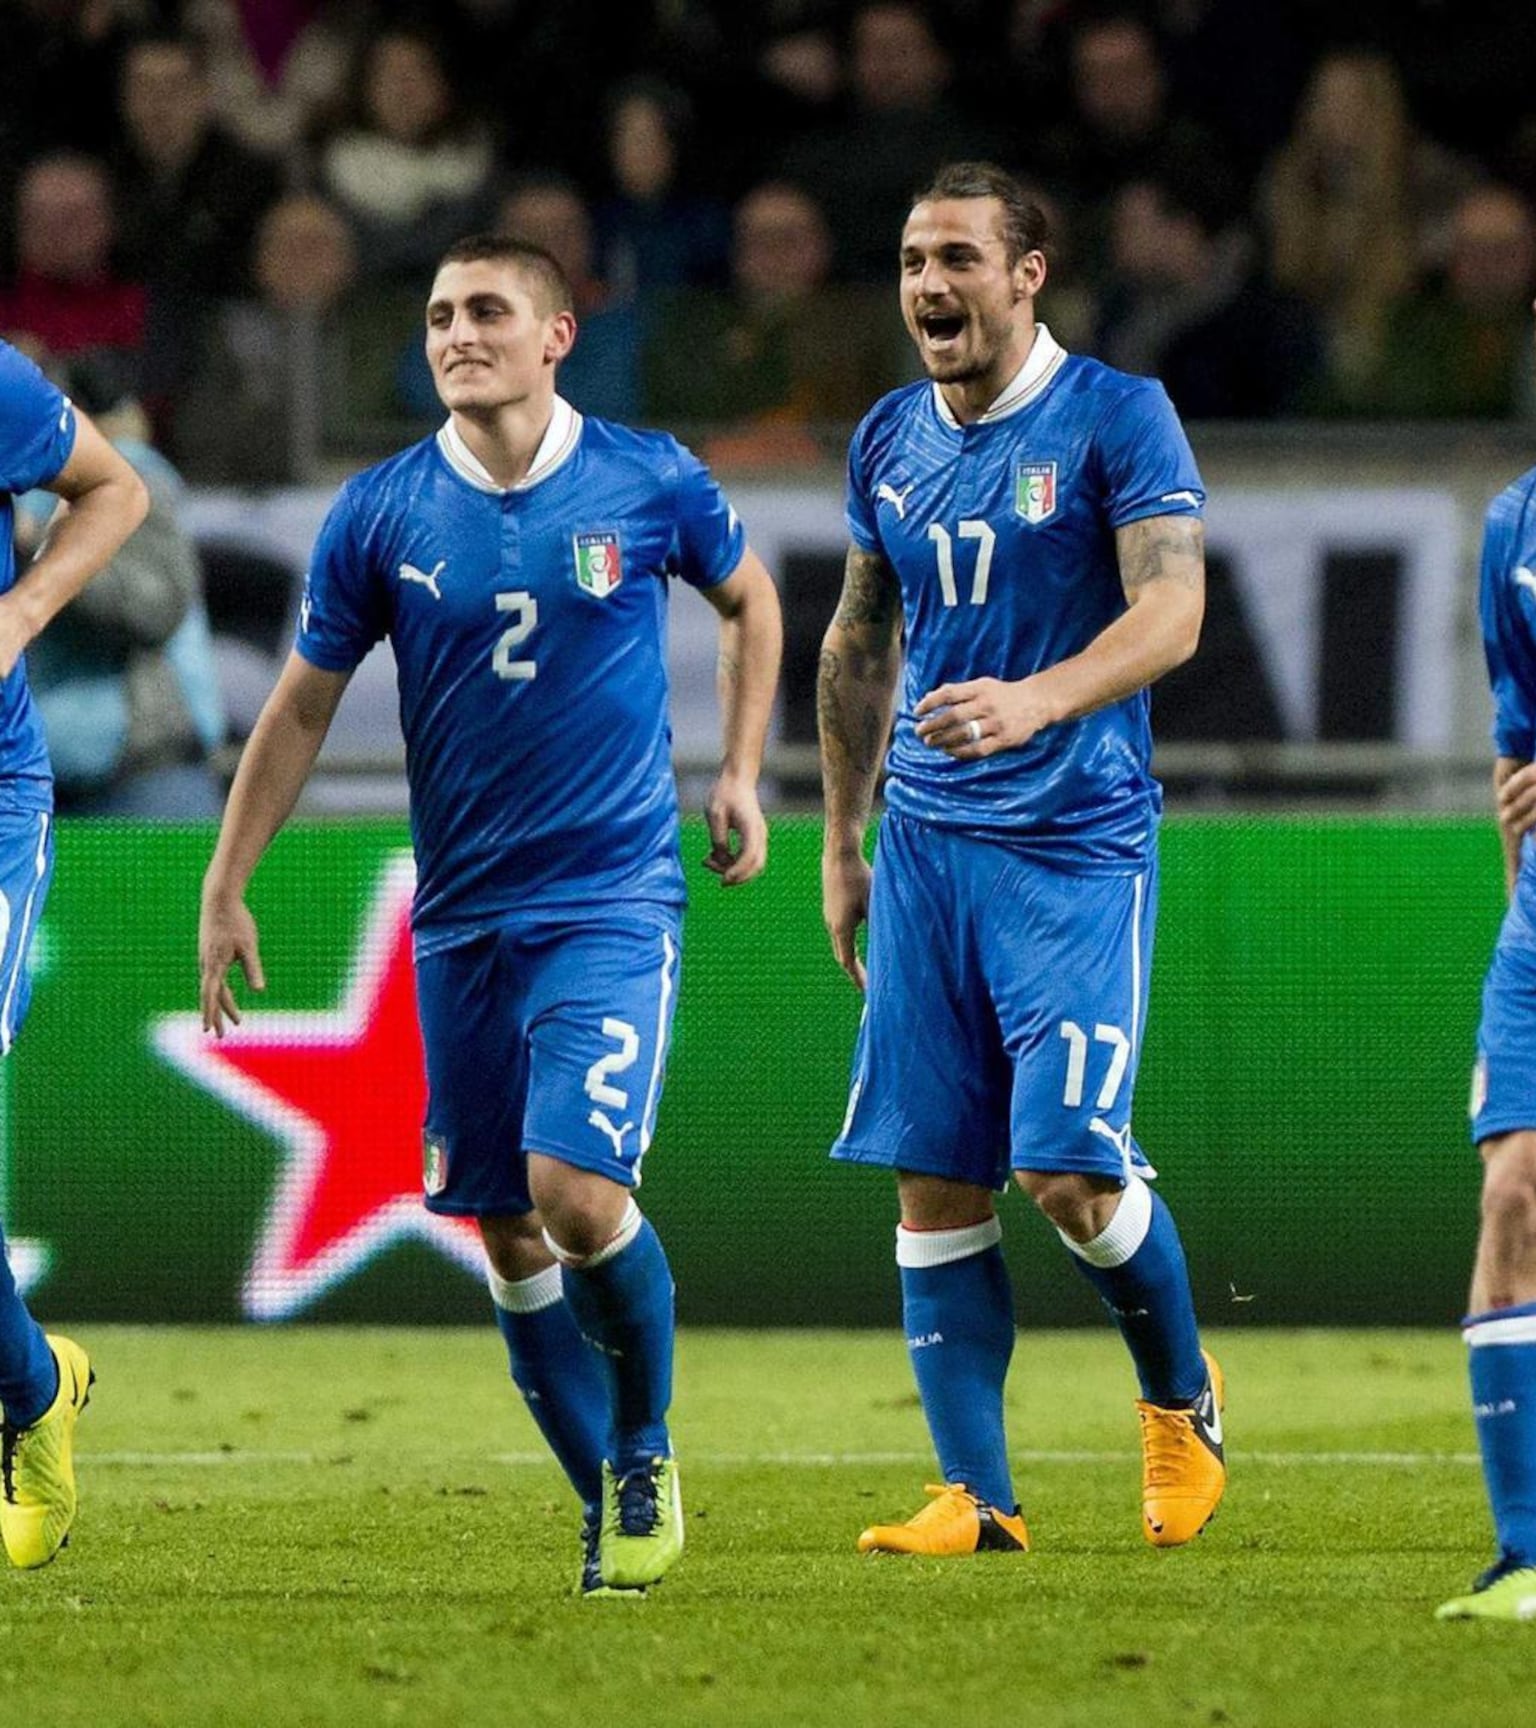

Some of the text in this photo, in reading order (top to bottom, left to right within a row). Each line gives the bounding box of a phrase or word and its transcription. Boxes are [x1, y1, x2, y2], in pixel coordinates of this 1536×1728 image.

[928, 520, 997, 607] 17
[492, 591, 538, 680] 2
[584, 1016, 640, 1110] 2
[1061, 1020, 1131, 1110] 17
